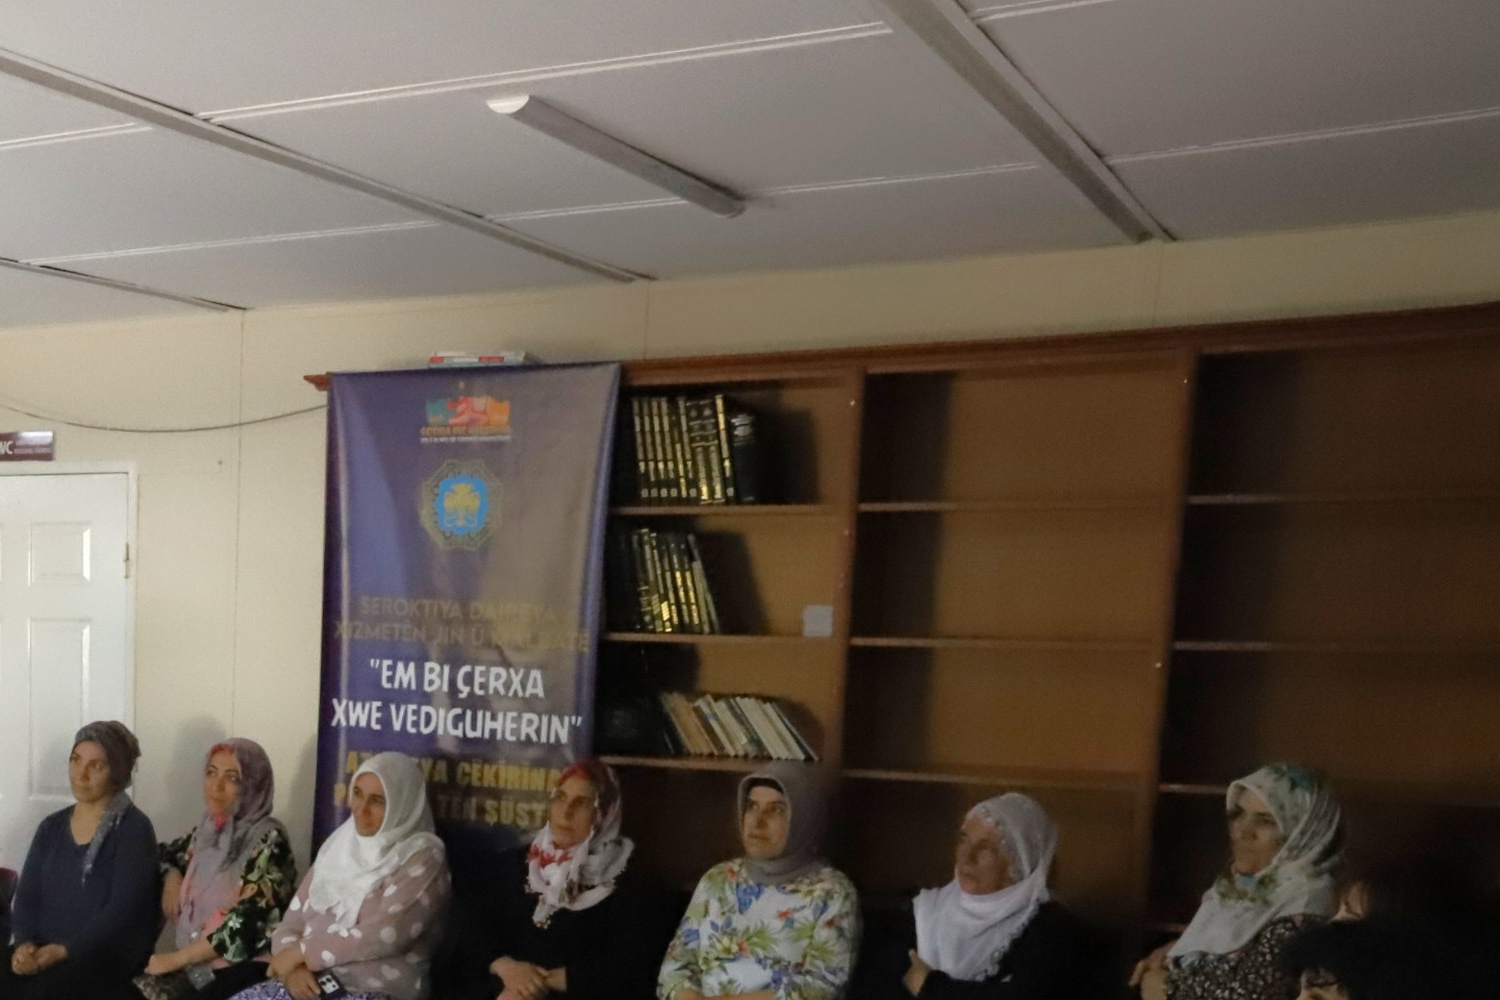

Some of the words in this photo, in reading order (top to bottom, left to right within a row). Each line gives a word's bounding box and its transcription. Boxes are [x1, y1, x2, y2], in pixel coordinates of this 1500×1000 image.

[423, 661, 450, 693] BI
[457, 664, 546, 699] ÇERXA
[331, 698, 383, 731] XWE
